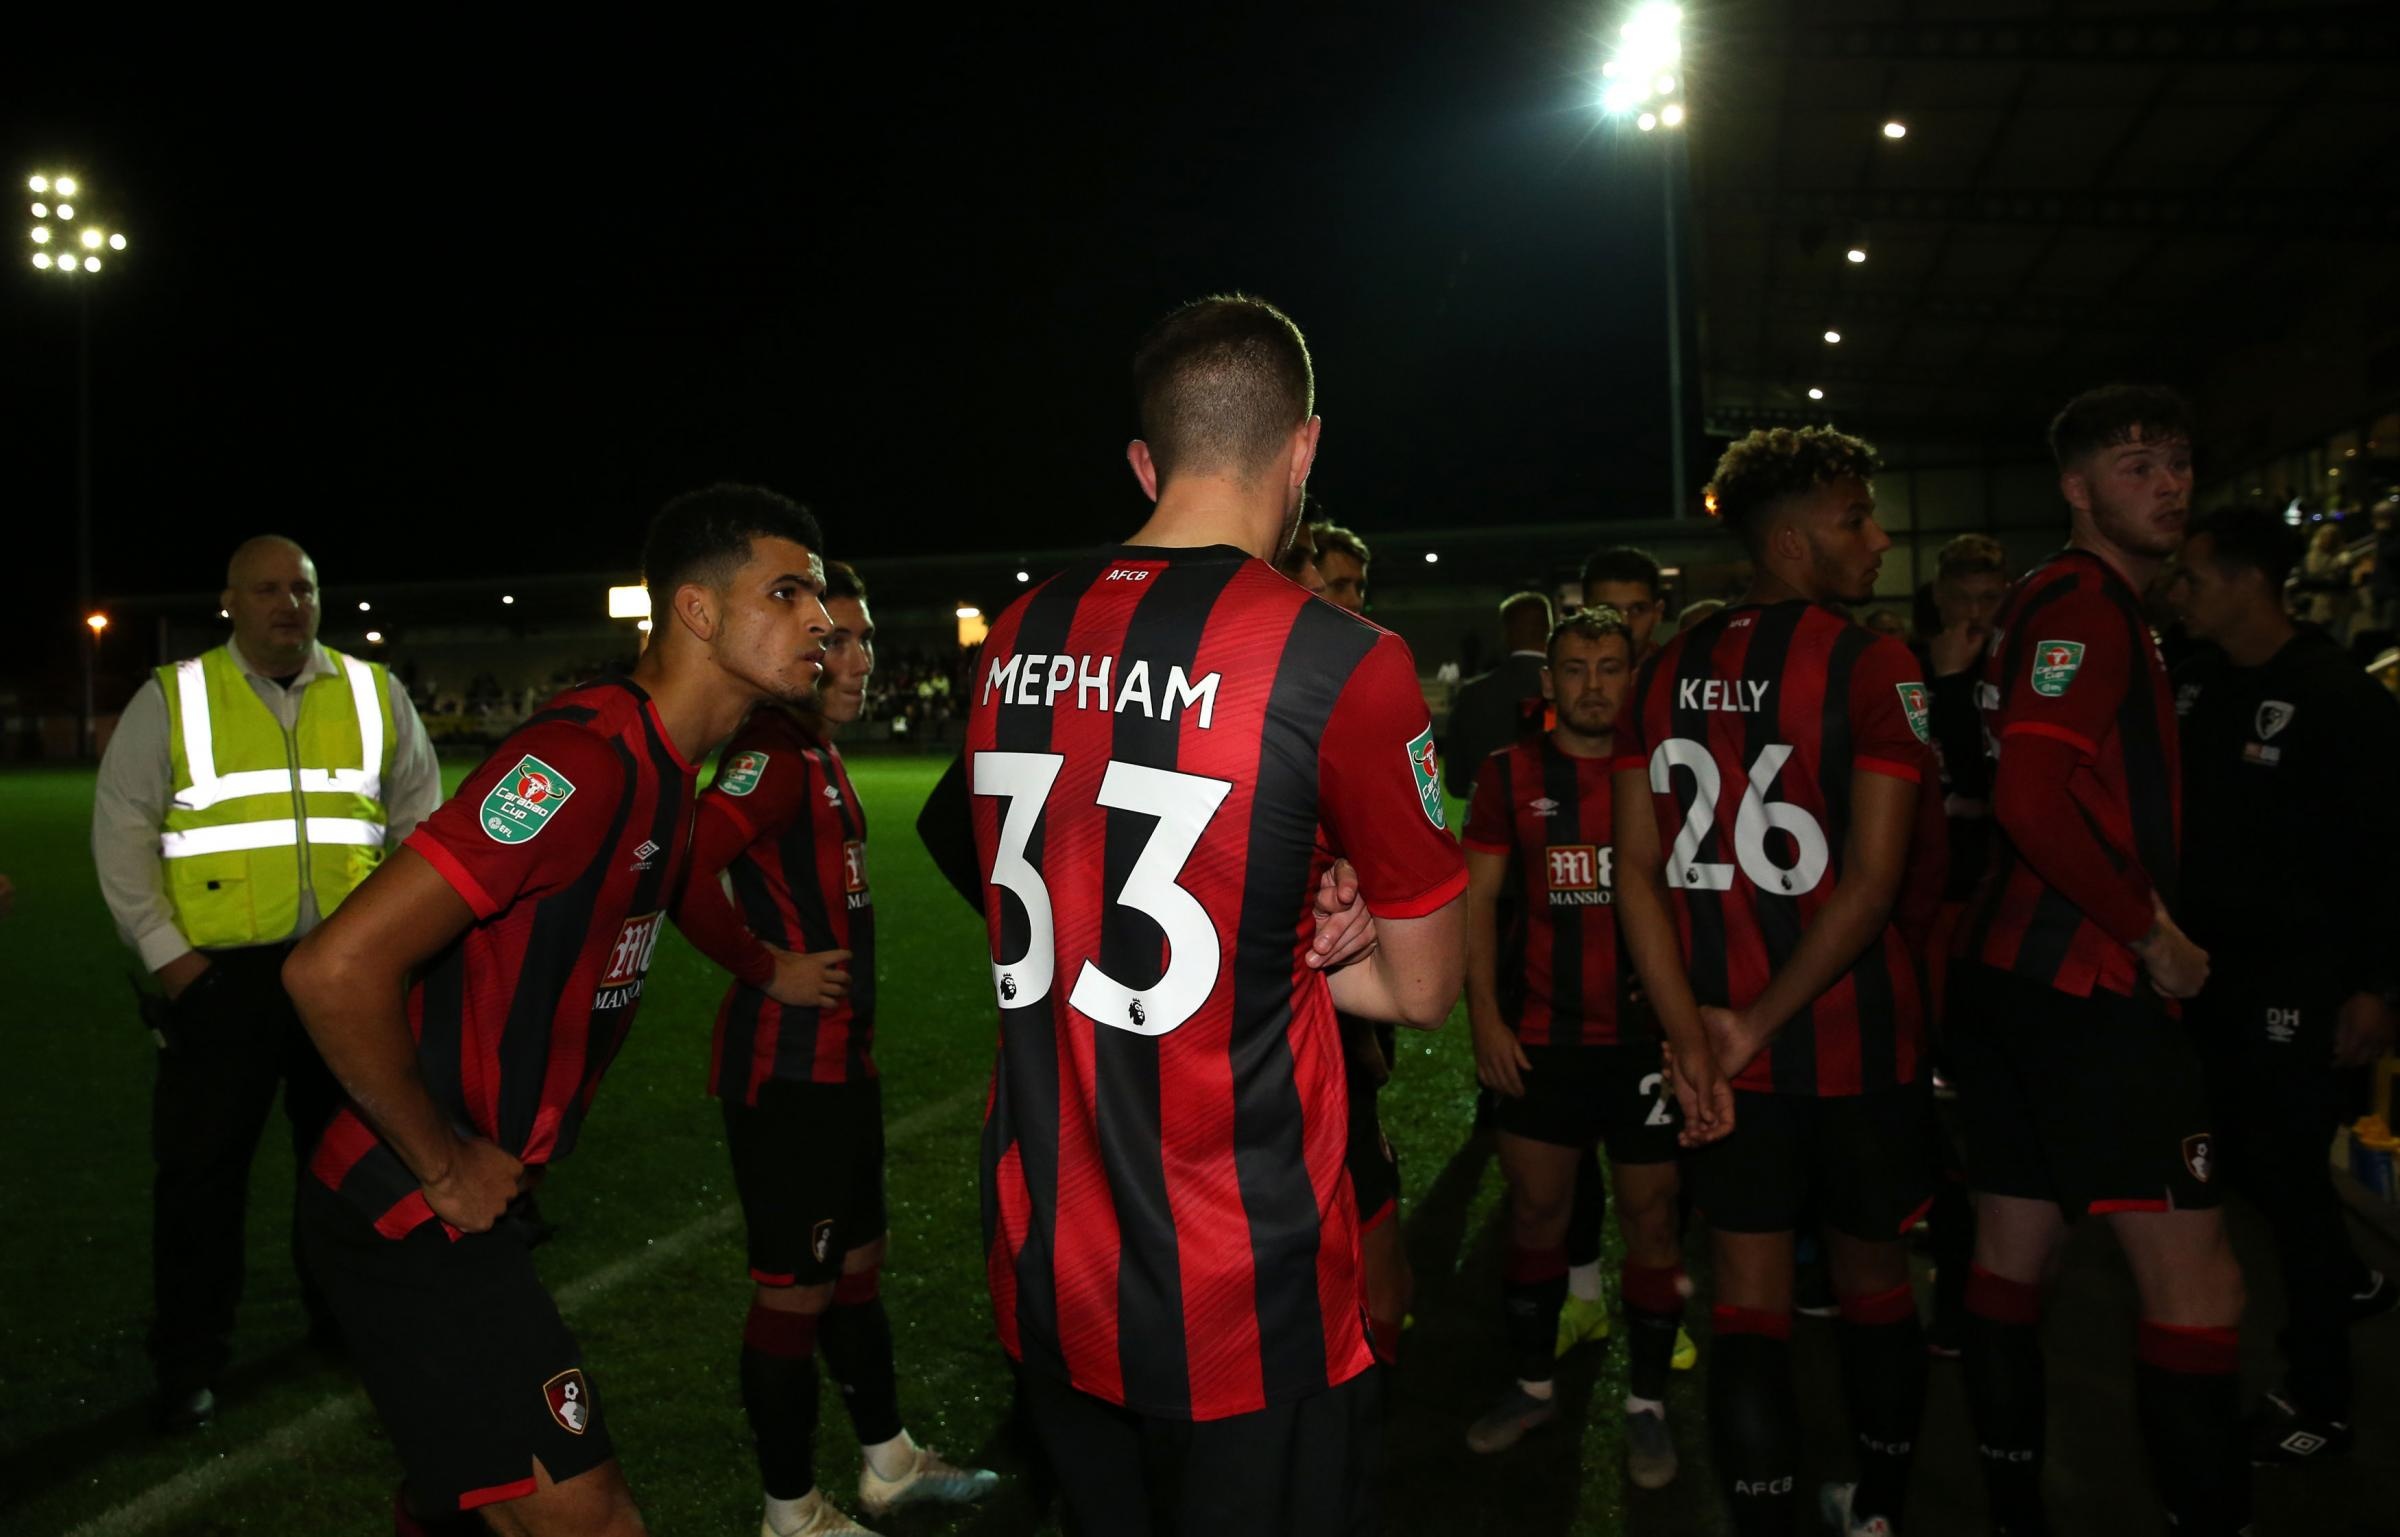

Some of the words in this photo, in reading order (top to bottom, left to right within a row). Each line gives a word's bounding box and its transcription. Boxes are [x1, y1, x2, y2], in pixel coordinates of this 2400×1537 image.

[1105, 569, 1149, 581] AFCB
[982, 653, 1222, 730] MEPHAM
[1679, 677, 1770, 713] KELLY
[495, 787, 549, 818] Carabao
[501, 801, 528, 820] Cup
[1649, 737, 1829, 896] 26
[499, 824, 513, 838] EFL
[972, 751, 1233, 1037] 33
[1548, 890, 1613, 906] MANSIO
[2265, 1007, 2301, 1027] DH
[1734, 1475, 1794, 1498] AFCB
